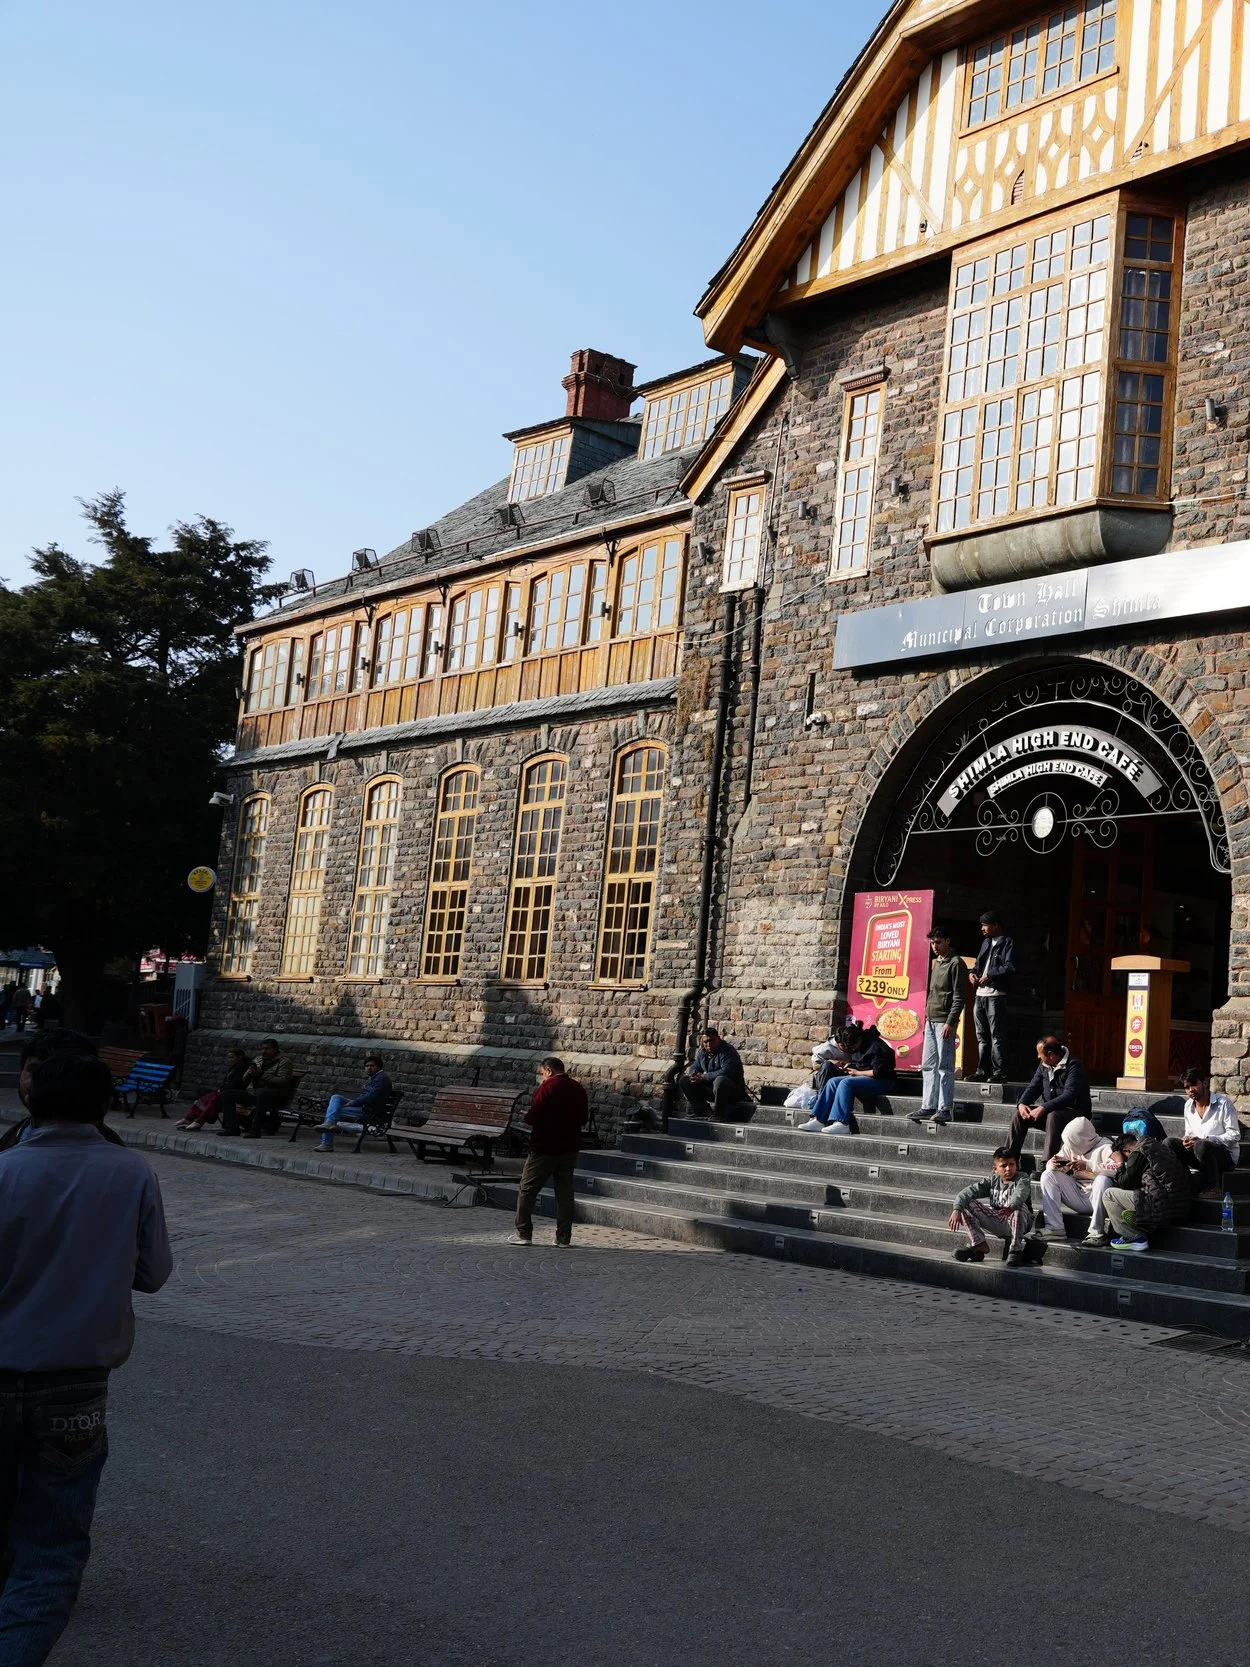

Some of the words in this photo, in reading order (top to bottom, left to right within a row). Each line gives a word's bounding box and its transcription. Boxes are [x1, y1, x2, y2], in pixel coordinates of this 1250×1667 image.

[977, 592, 1026, 614] Town
[1035, 581, 1077, 606] Hall
[900, 622, 978, 652] Municipal
[984, 606, 1084, 638] Corporation
[1092, 592, 1162, 621] Shimla
[948, 744, 1008, 799] SHIMLA
[1012, 730, 1055, 753] HIGH
[1059, 730, 1095, 750] END
[988, 769, 1024, 795] SHIMLA
[1026, 762, 1050, 776] HIGH
[1053, 761, 1075, 774] END
[874, 895, 898, 903] BIRYANI
[892, 920, 906, 929] MOST
[880, 930, 900, 940] LOVED
[877, 938, 901, 949] BIRYANI
[871, 948, 902, 963] STARTING
[874, 966, 892, 976] From
[887, 986, 906, 996] ONLY
